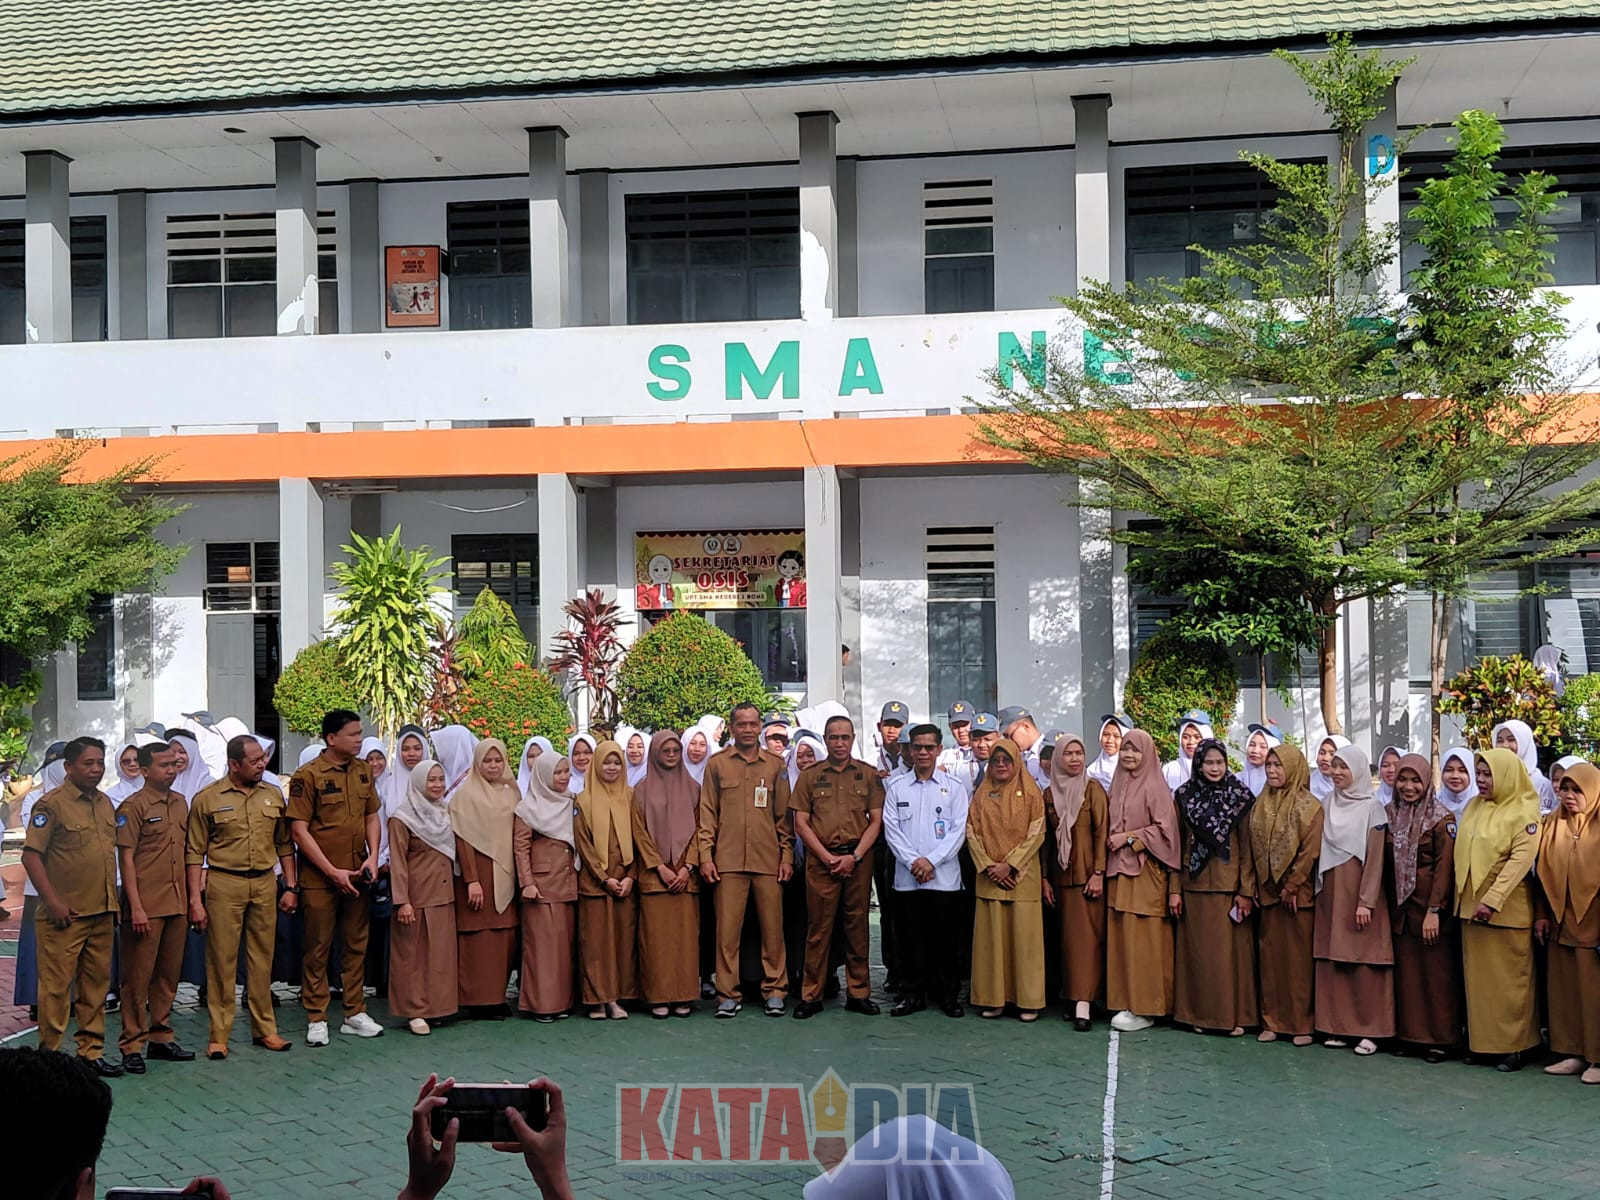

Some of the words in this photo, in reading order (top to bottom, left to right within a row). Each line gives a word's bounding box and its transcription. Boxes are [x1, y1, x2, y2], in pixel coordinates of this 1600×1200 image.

[646, 337, 884, 401] SMA
[673, 554, 777, 569] SEKRETARIAT
[697, 570, 749, 589] OSIS
